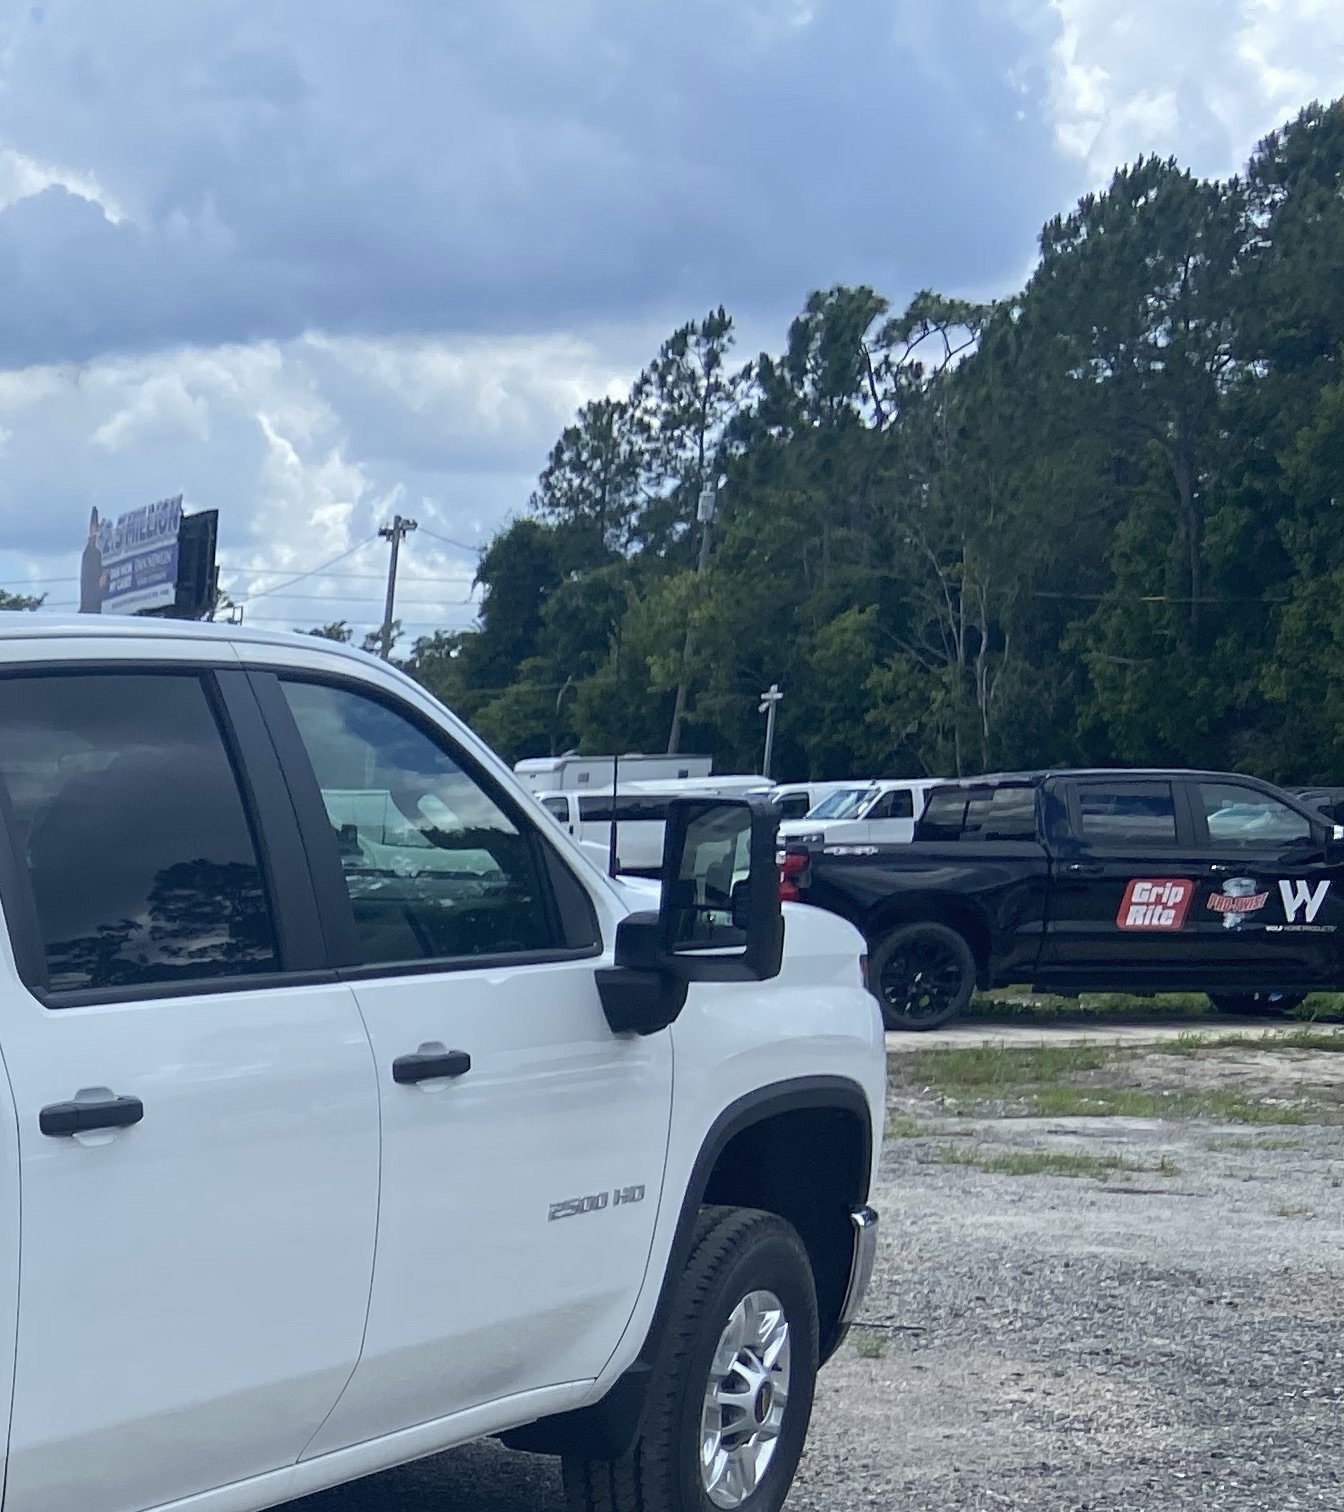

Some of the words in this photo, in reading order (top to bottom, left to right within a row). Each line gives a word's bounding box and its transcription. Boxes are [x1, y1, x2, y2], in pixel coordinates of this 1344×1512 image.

[125, 497, 182, 547] MILLION
[1131, 882, 1185, 904] Grip
[1278, 880, 1331, 922] W
[1125, 905, 1176, 926] Rite
[548, 1192, 609, 1221] 2500
[613, 1184, 645, 1206] HD
